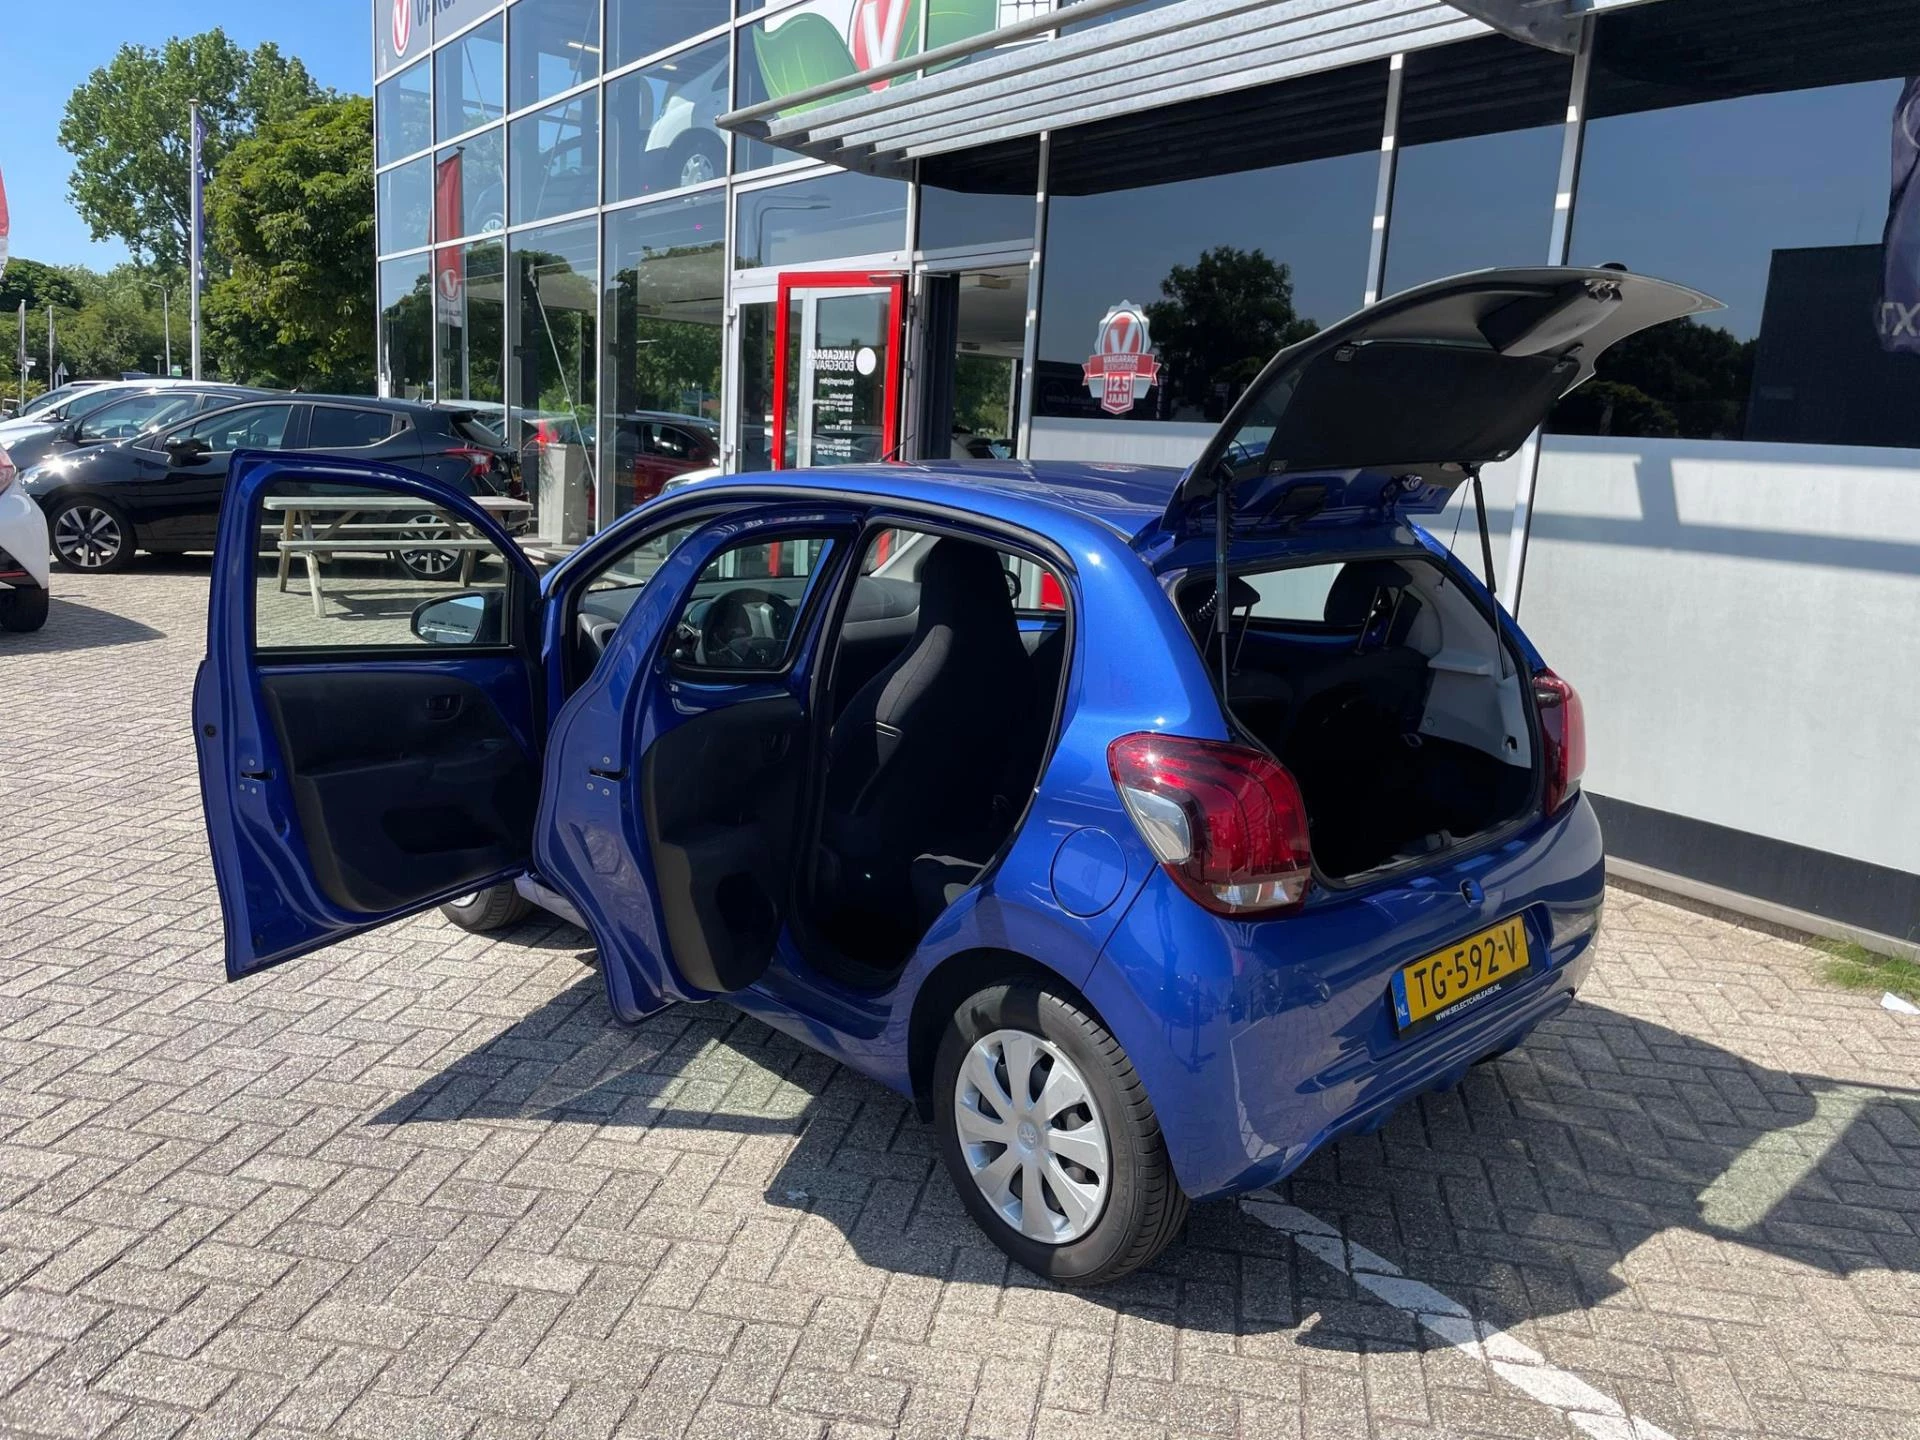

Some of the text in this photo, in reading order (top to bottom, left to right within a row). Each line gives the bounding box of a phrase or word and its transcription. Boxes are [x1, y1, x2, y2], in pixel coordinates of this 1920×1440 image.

[1107, 393, 1128, 404] JAAR
[1414, 925, 1516, 1008] TG-592-V
[1397, 1003, 1408, 1018] NL
